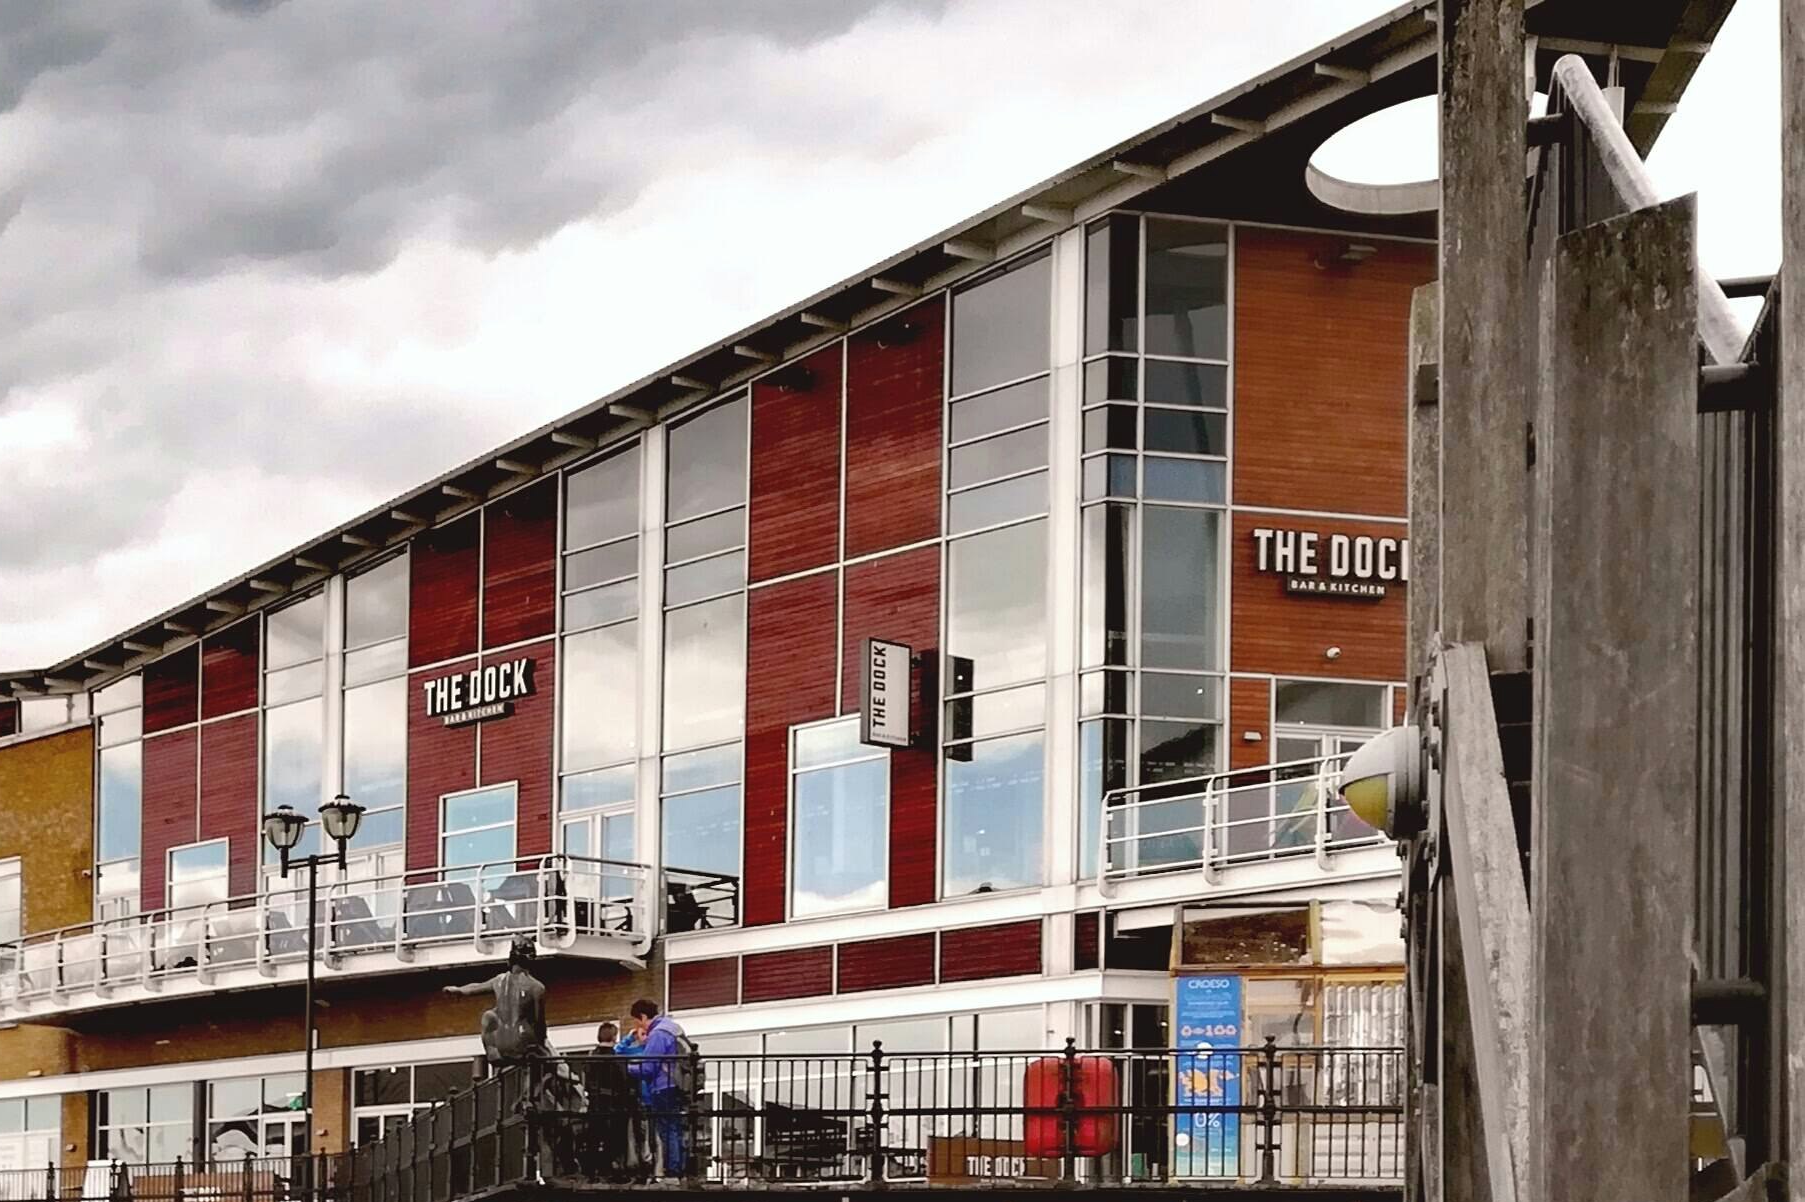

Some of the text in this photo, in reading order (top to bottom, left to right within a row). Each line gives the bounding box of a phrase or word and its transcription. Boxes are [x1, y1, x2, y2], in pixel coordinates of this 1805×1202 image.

[1254, 529, 1318, 574] THE
[1291, 580, 1315, 590] BAR
[1330, 582, 1385, 595] KITCHEN
[424, 658, 527, 716] THE DOCK
[873, 645, 886, 728] THE DOCK
